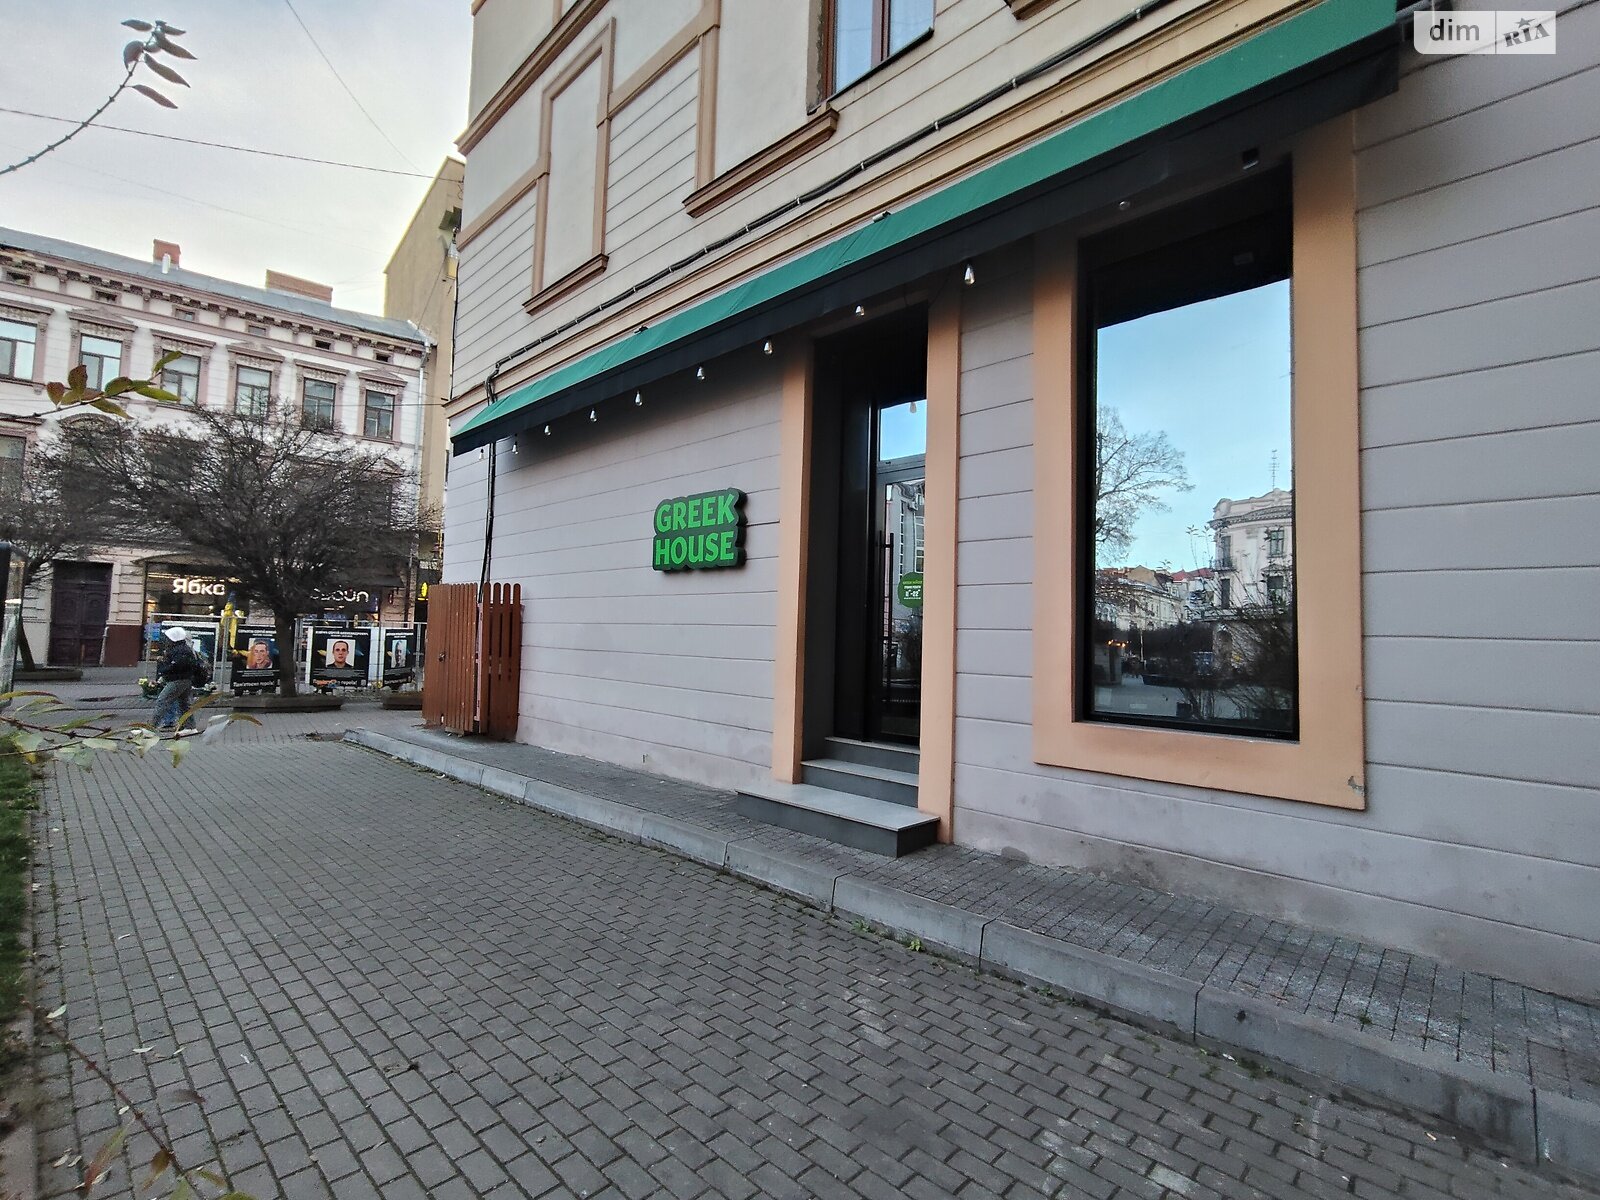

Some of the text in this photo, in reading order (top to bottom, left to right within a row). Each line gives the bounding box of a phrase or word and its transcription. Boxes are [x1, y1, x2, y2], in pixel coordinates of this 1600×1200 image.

[656, 494, 736, 533] GREEK
[655, 532, 734, 566] HOUSE
[173, 578, 226, 596] Ябко
